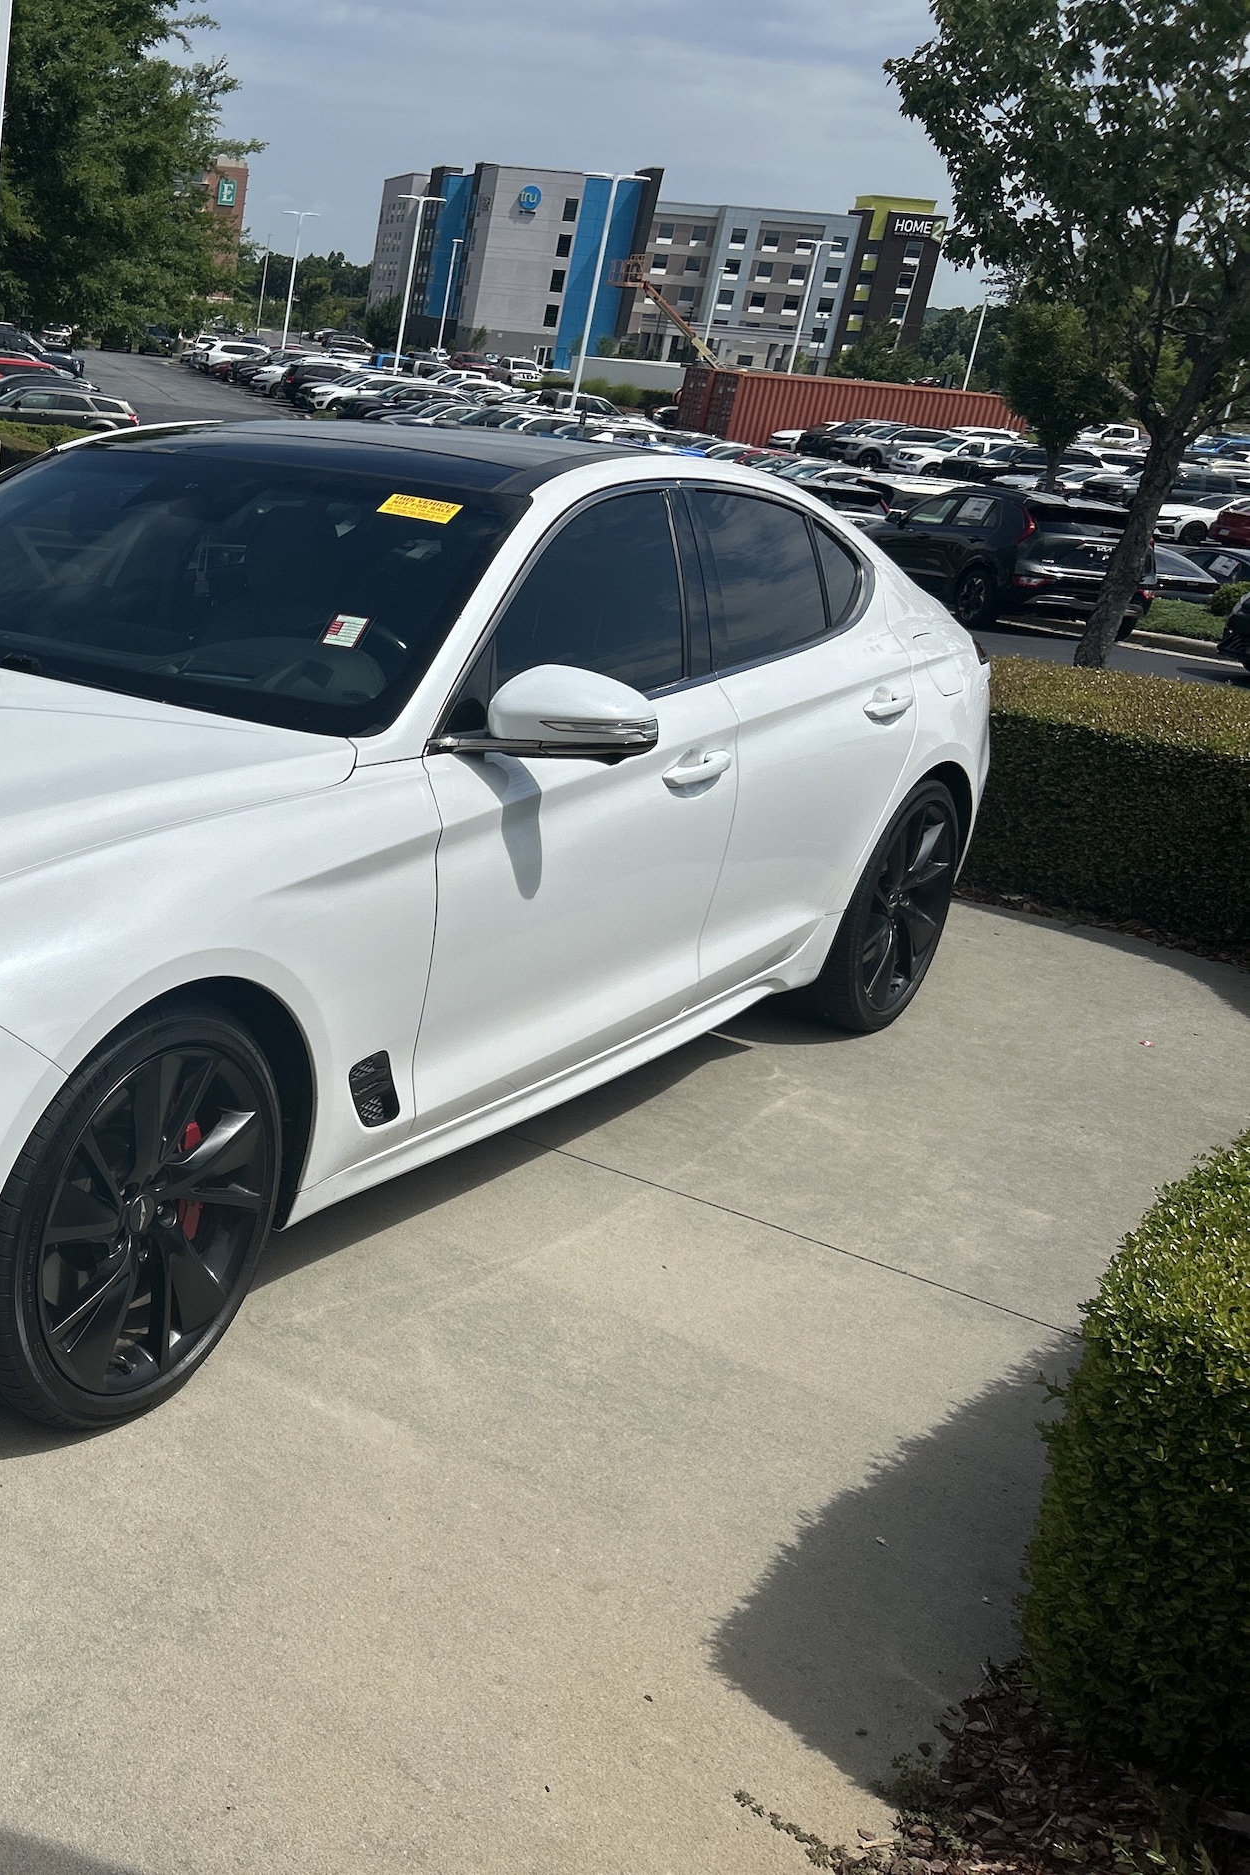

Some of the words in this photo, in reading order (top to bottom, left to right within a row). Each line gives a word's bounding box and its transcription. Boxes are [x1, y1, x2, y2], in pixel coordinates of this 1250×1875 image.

[221, 183, 233, 202] E
[520, 191, 537, 203] tru
[894, 219, 933, 234] HOME
[395, 495, 415, 503] THIS
[419, 499, 458, 511] VEHICLE
[430, 506, 453, 514] SALE
